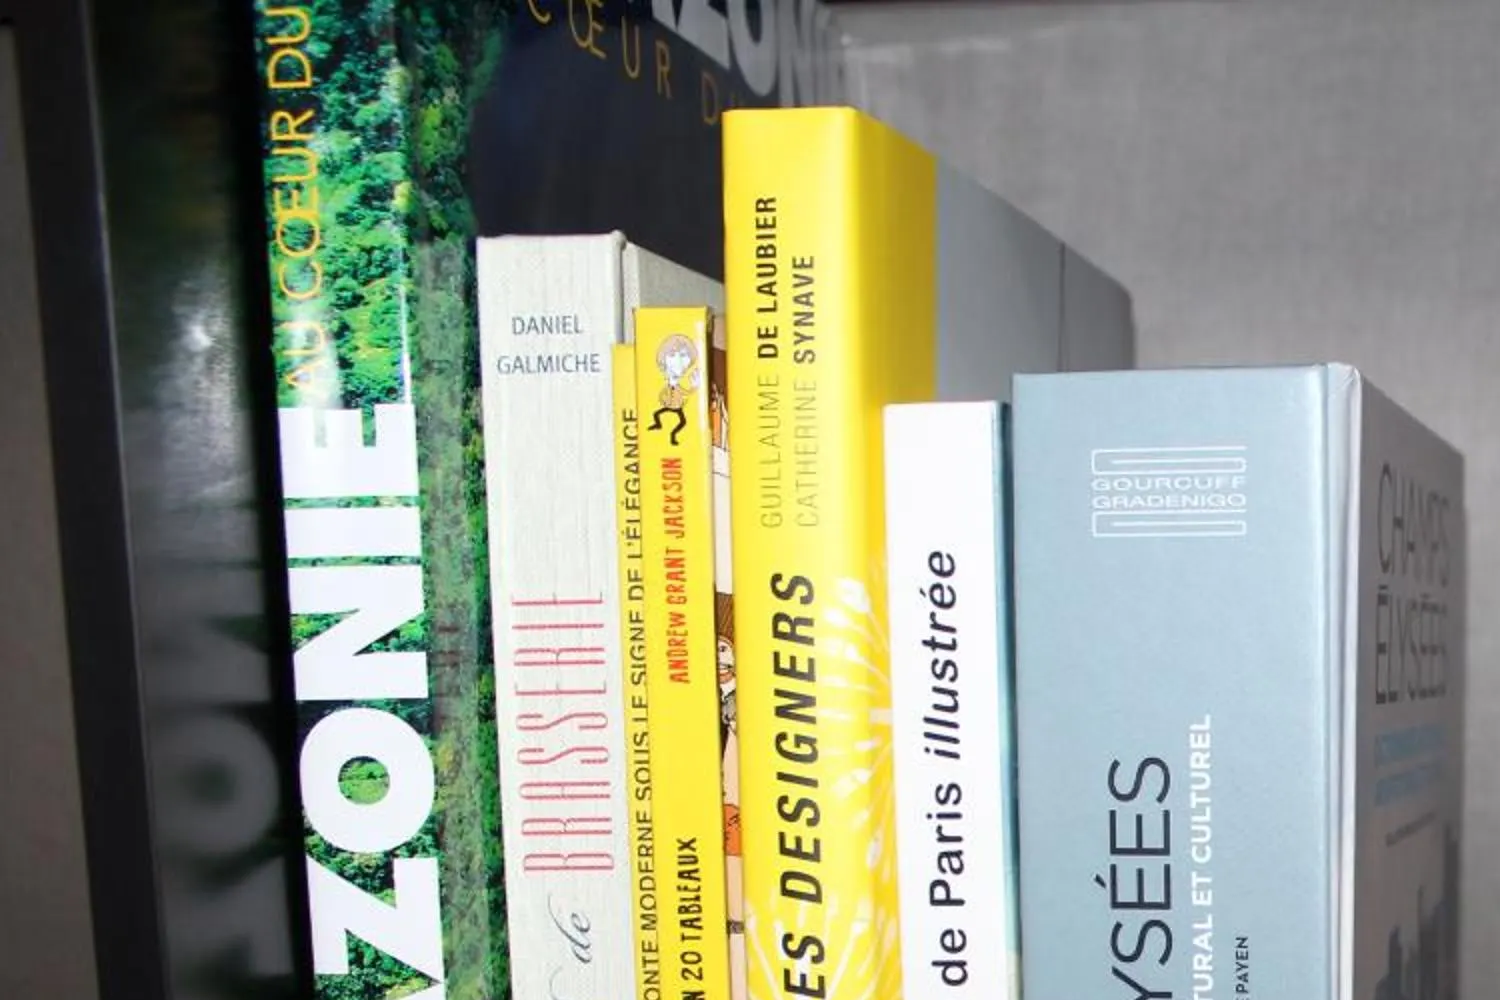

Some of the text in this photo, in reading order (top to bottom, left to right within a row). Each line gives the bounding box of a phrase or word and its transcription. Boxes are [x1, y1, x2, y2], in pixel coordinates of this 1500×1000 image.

[264, 6, 326, 397] AU CŒUR DU
[512, 315, 583, 335] DANIEL
[755, 196, 783, 529] GUILLAUME DE LAUBIER
[497, 353, 601, 375] GALMICHE
[792, 255, 820, 528] CATHERINE SYNAVE
[1091, 475, 1246, 491] GOURCUFF
[1091, 493, 1246, 509] GRADENIGO
[626, 568, 645, 599] DE
[661, 457, 691, 684] ANDREW GRANT JACKSON
[627, 609, 648, 688] SIGNE
[919, 550, 961, 759] illustrée
[511, 591, 615, 872] BRASSERIE
[628, 696, 649, 721] LE
[770, 571, 823, 904] DESIGNERS
[632, 731, 653, 800] SOUS
[1189, 713, 1213, 864] CULTUREL
[633, 811, 658, 932] MODERNE
[926, 781, 965, 907] Paris
[676, 836, 704, 945] TABLEAUX
[1192, 871, 1213, 906] ET
[548, 891, 594, 964] de
[680, 951, 704, 980] 20
[931, 927, 969, 986] de
[1235, 936, 1250, 993] PAYEN
